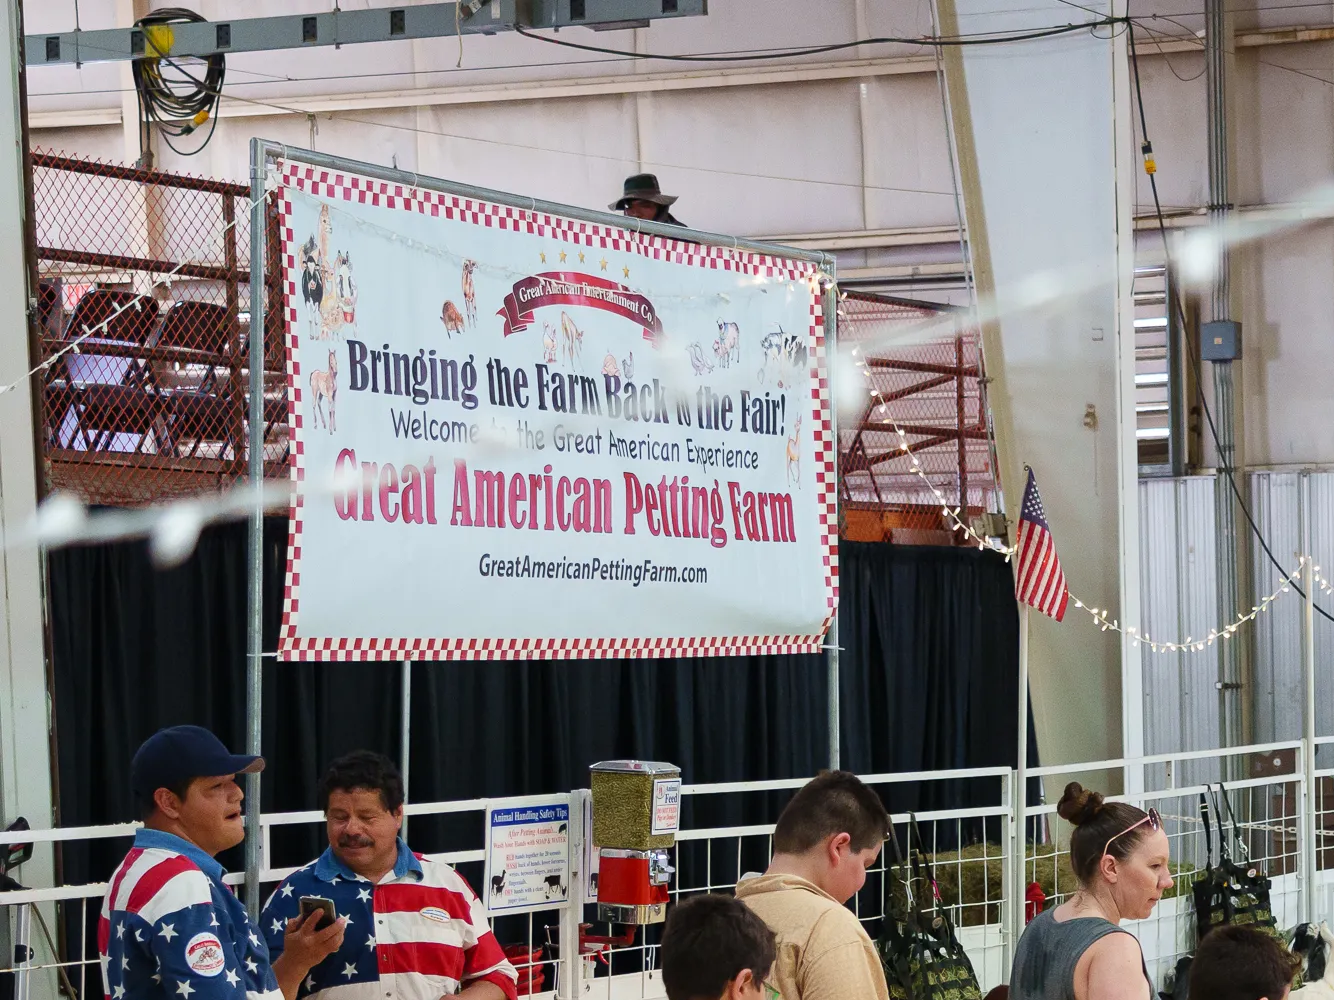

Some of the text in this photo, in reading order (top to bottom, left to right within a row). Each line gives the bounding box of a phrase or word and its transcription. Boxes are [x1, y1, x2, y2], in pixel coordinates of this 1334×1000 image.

[519, 280, 654, 325] Great American Entertainment Co.
[346, 339, 479, 410] Bringing
[486, 357, 530, 409] the
[535, 363, 603, 416] Farm
[603, 373, 670, 424] Back
[697, 385, 733, 431] the
[740, 390, 786, 436] Fair!
[390, 408, 480, 444] Welcome
[517, 420, 545, 450] the
[553, 424, 602, 454] Great
[609, 430, 680, 463] American
[686, 438, 759, 474] Experience
[333, 448, 797, 549] Great American Petting Farm
[479, 553, 708, 587] GreatAmericanPettingFarm.com
[493, 807, 568, 823] Animal Handling Safety Tips
[665, 793, 678, 803] Feed
